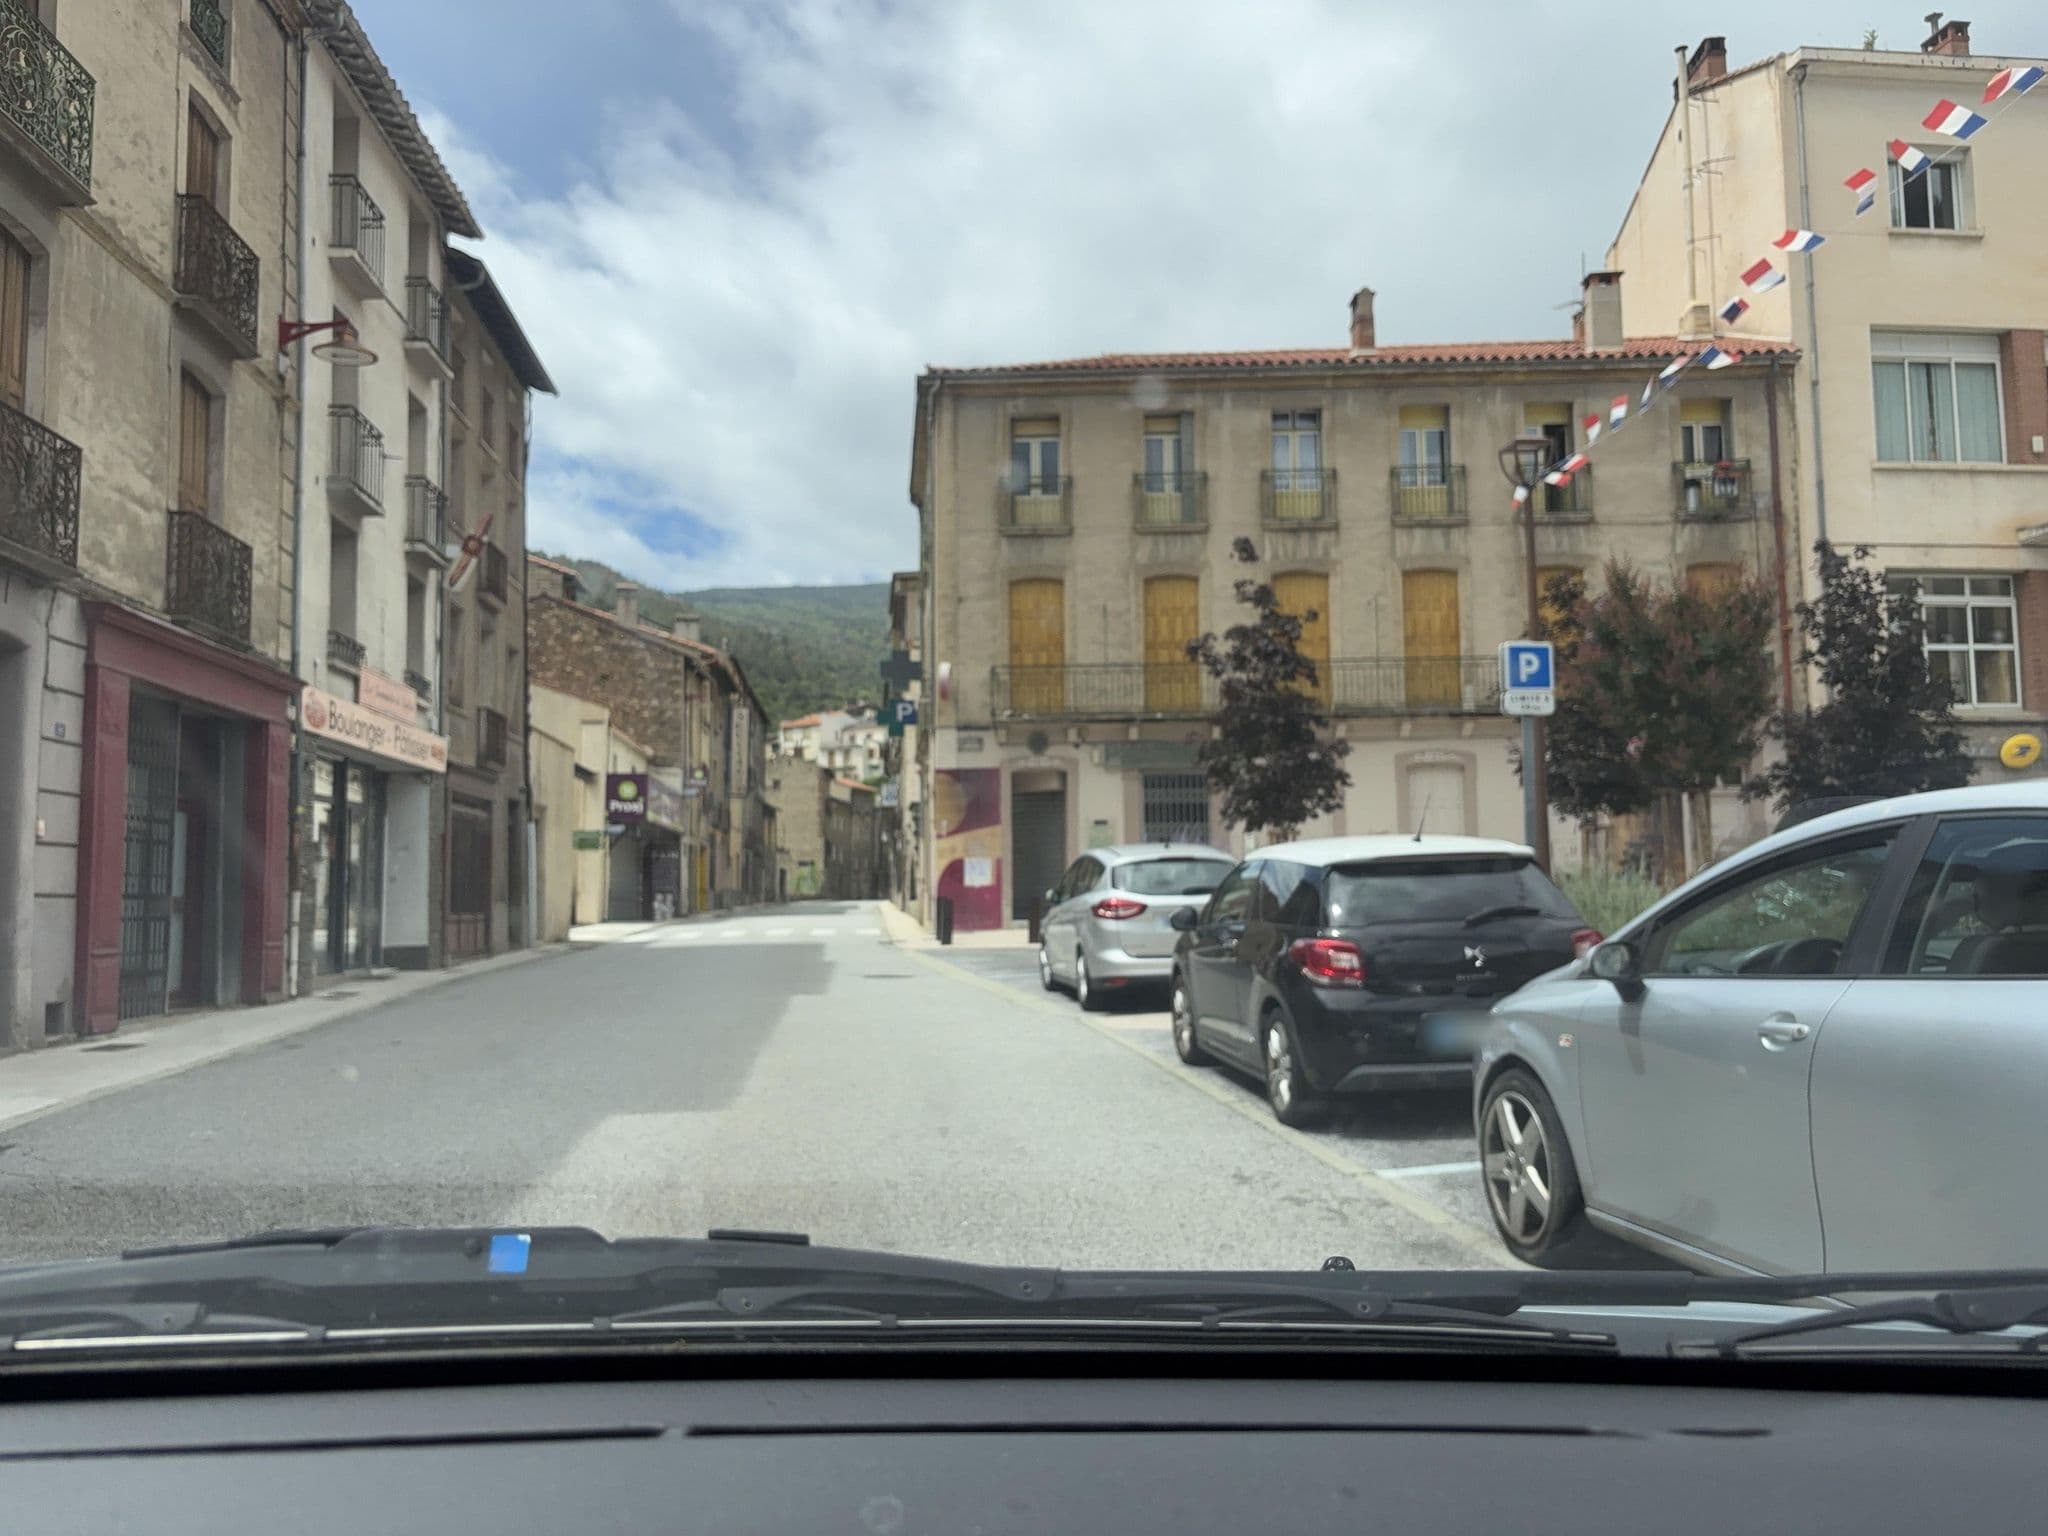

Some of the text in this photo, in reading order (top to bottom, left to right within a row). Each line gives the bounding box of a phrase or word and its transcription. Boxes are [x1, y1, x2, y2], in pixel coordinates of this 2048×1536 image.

[1518, 651, 1540, 683] P
[329, 699, 386, 750] Boulanger
[896, 702, 913, 721] P
